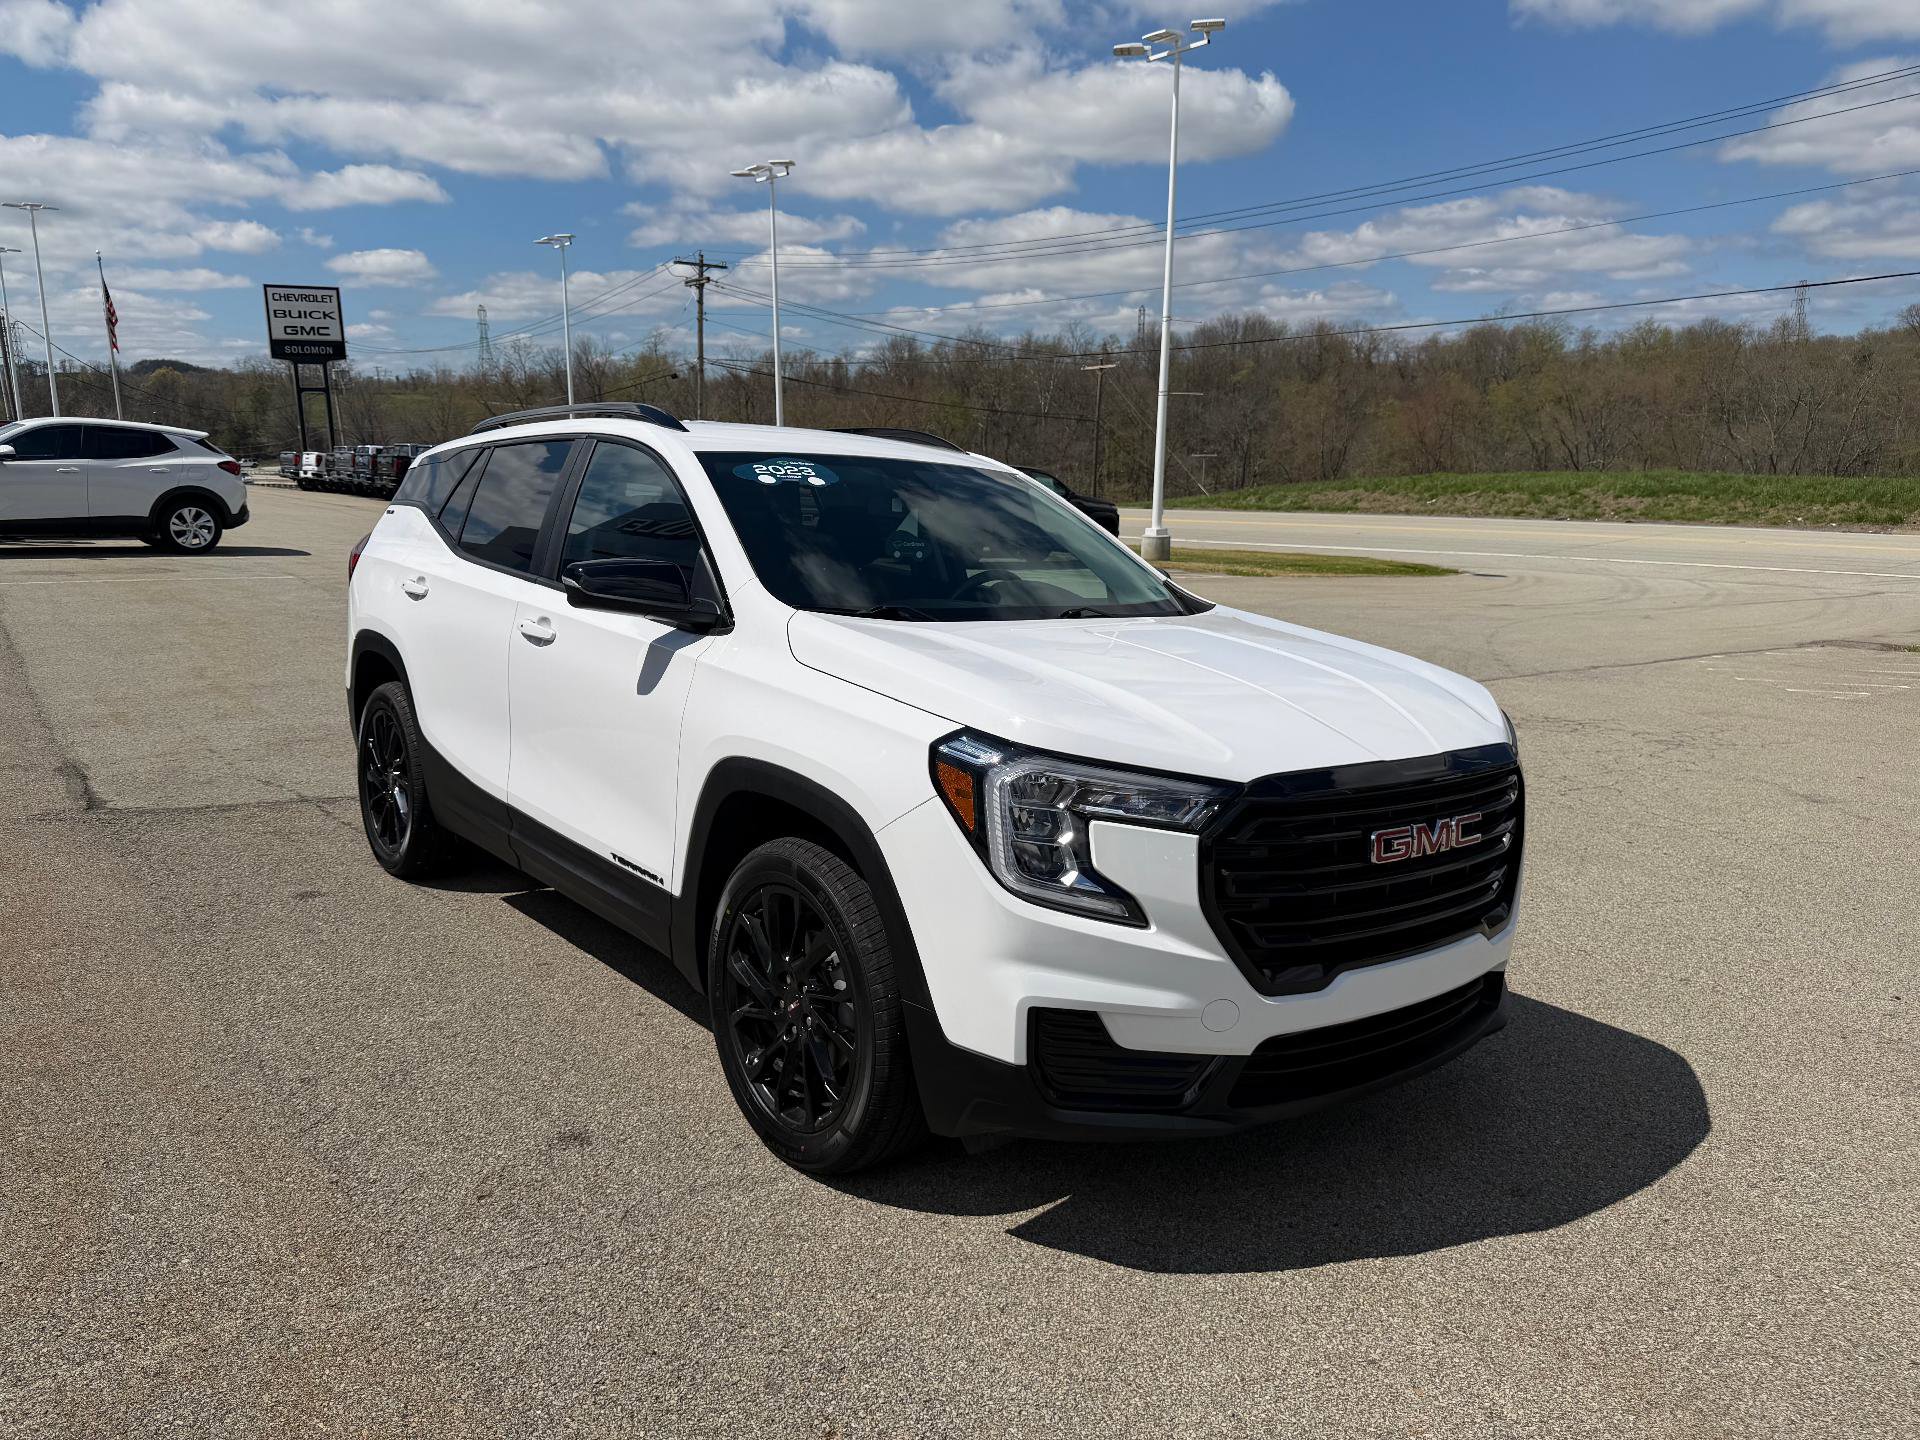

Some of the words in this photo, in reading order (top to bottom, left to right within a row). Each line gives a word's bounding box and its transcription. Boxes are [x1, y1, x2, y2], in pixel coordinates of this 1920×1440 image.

[272, 293, 333, 303] CHEVROLET
[273, 309, 336, 320] BUICK
[284, 325, 331, 336] GMC
[284, 345, 333, 355] SOLOMON
[753, 464, 815, 476] 2023
[1371, 812, 1482, 864] GMC
